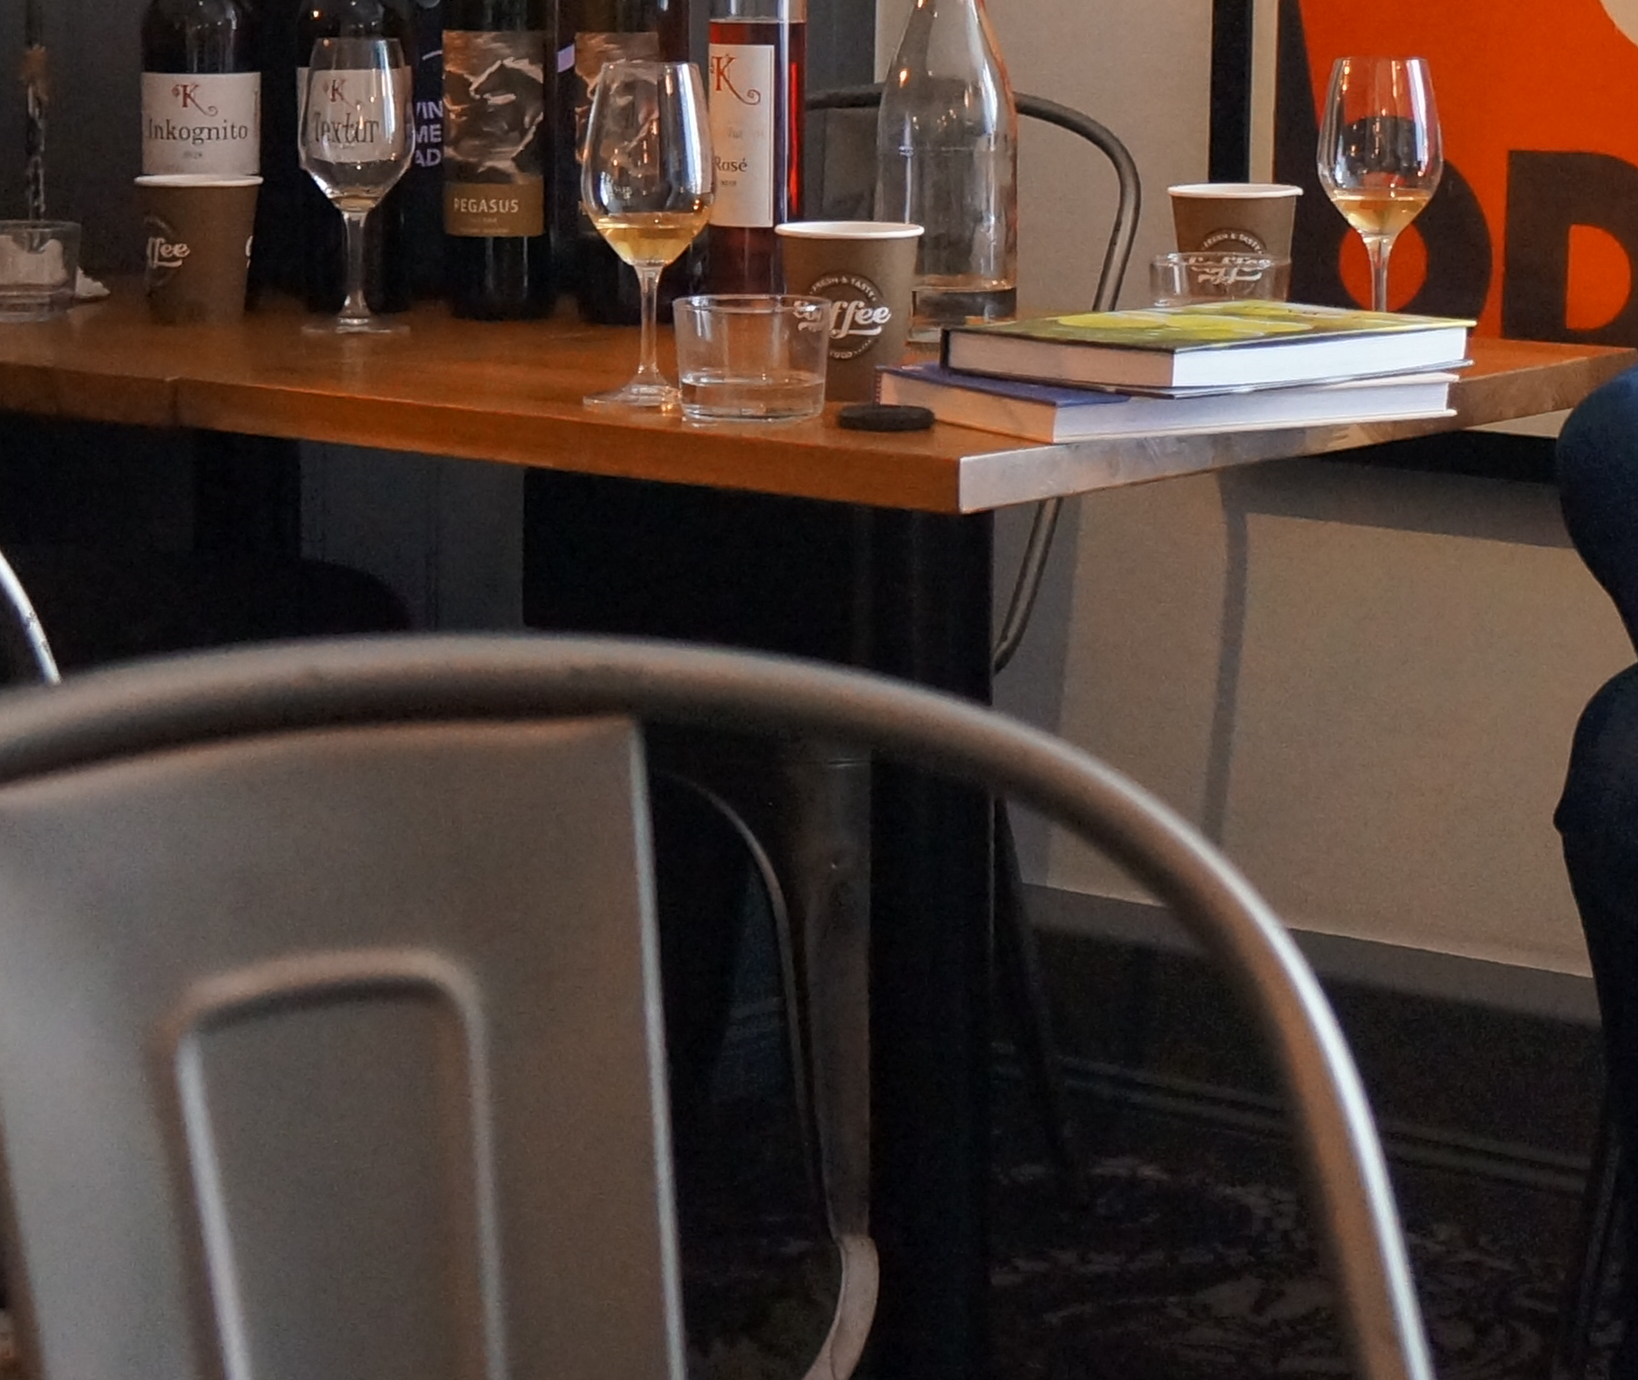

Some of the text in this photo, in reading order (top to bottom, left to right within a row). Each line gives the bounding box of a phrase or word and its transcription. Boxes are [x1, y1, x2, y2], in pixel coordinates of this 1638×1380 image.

[146, 118, 249, 145] Inkognito
[310, 112, 381, 144] Textur
[714, 156, 749, 173] Rosé
[453, 197, 520, 214] PEGASUS
[146, 237, 191, 269] ffee
